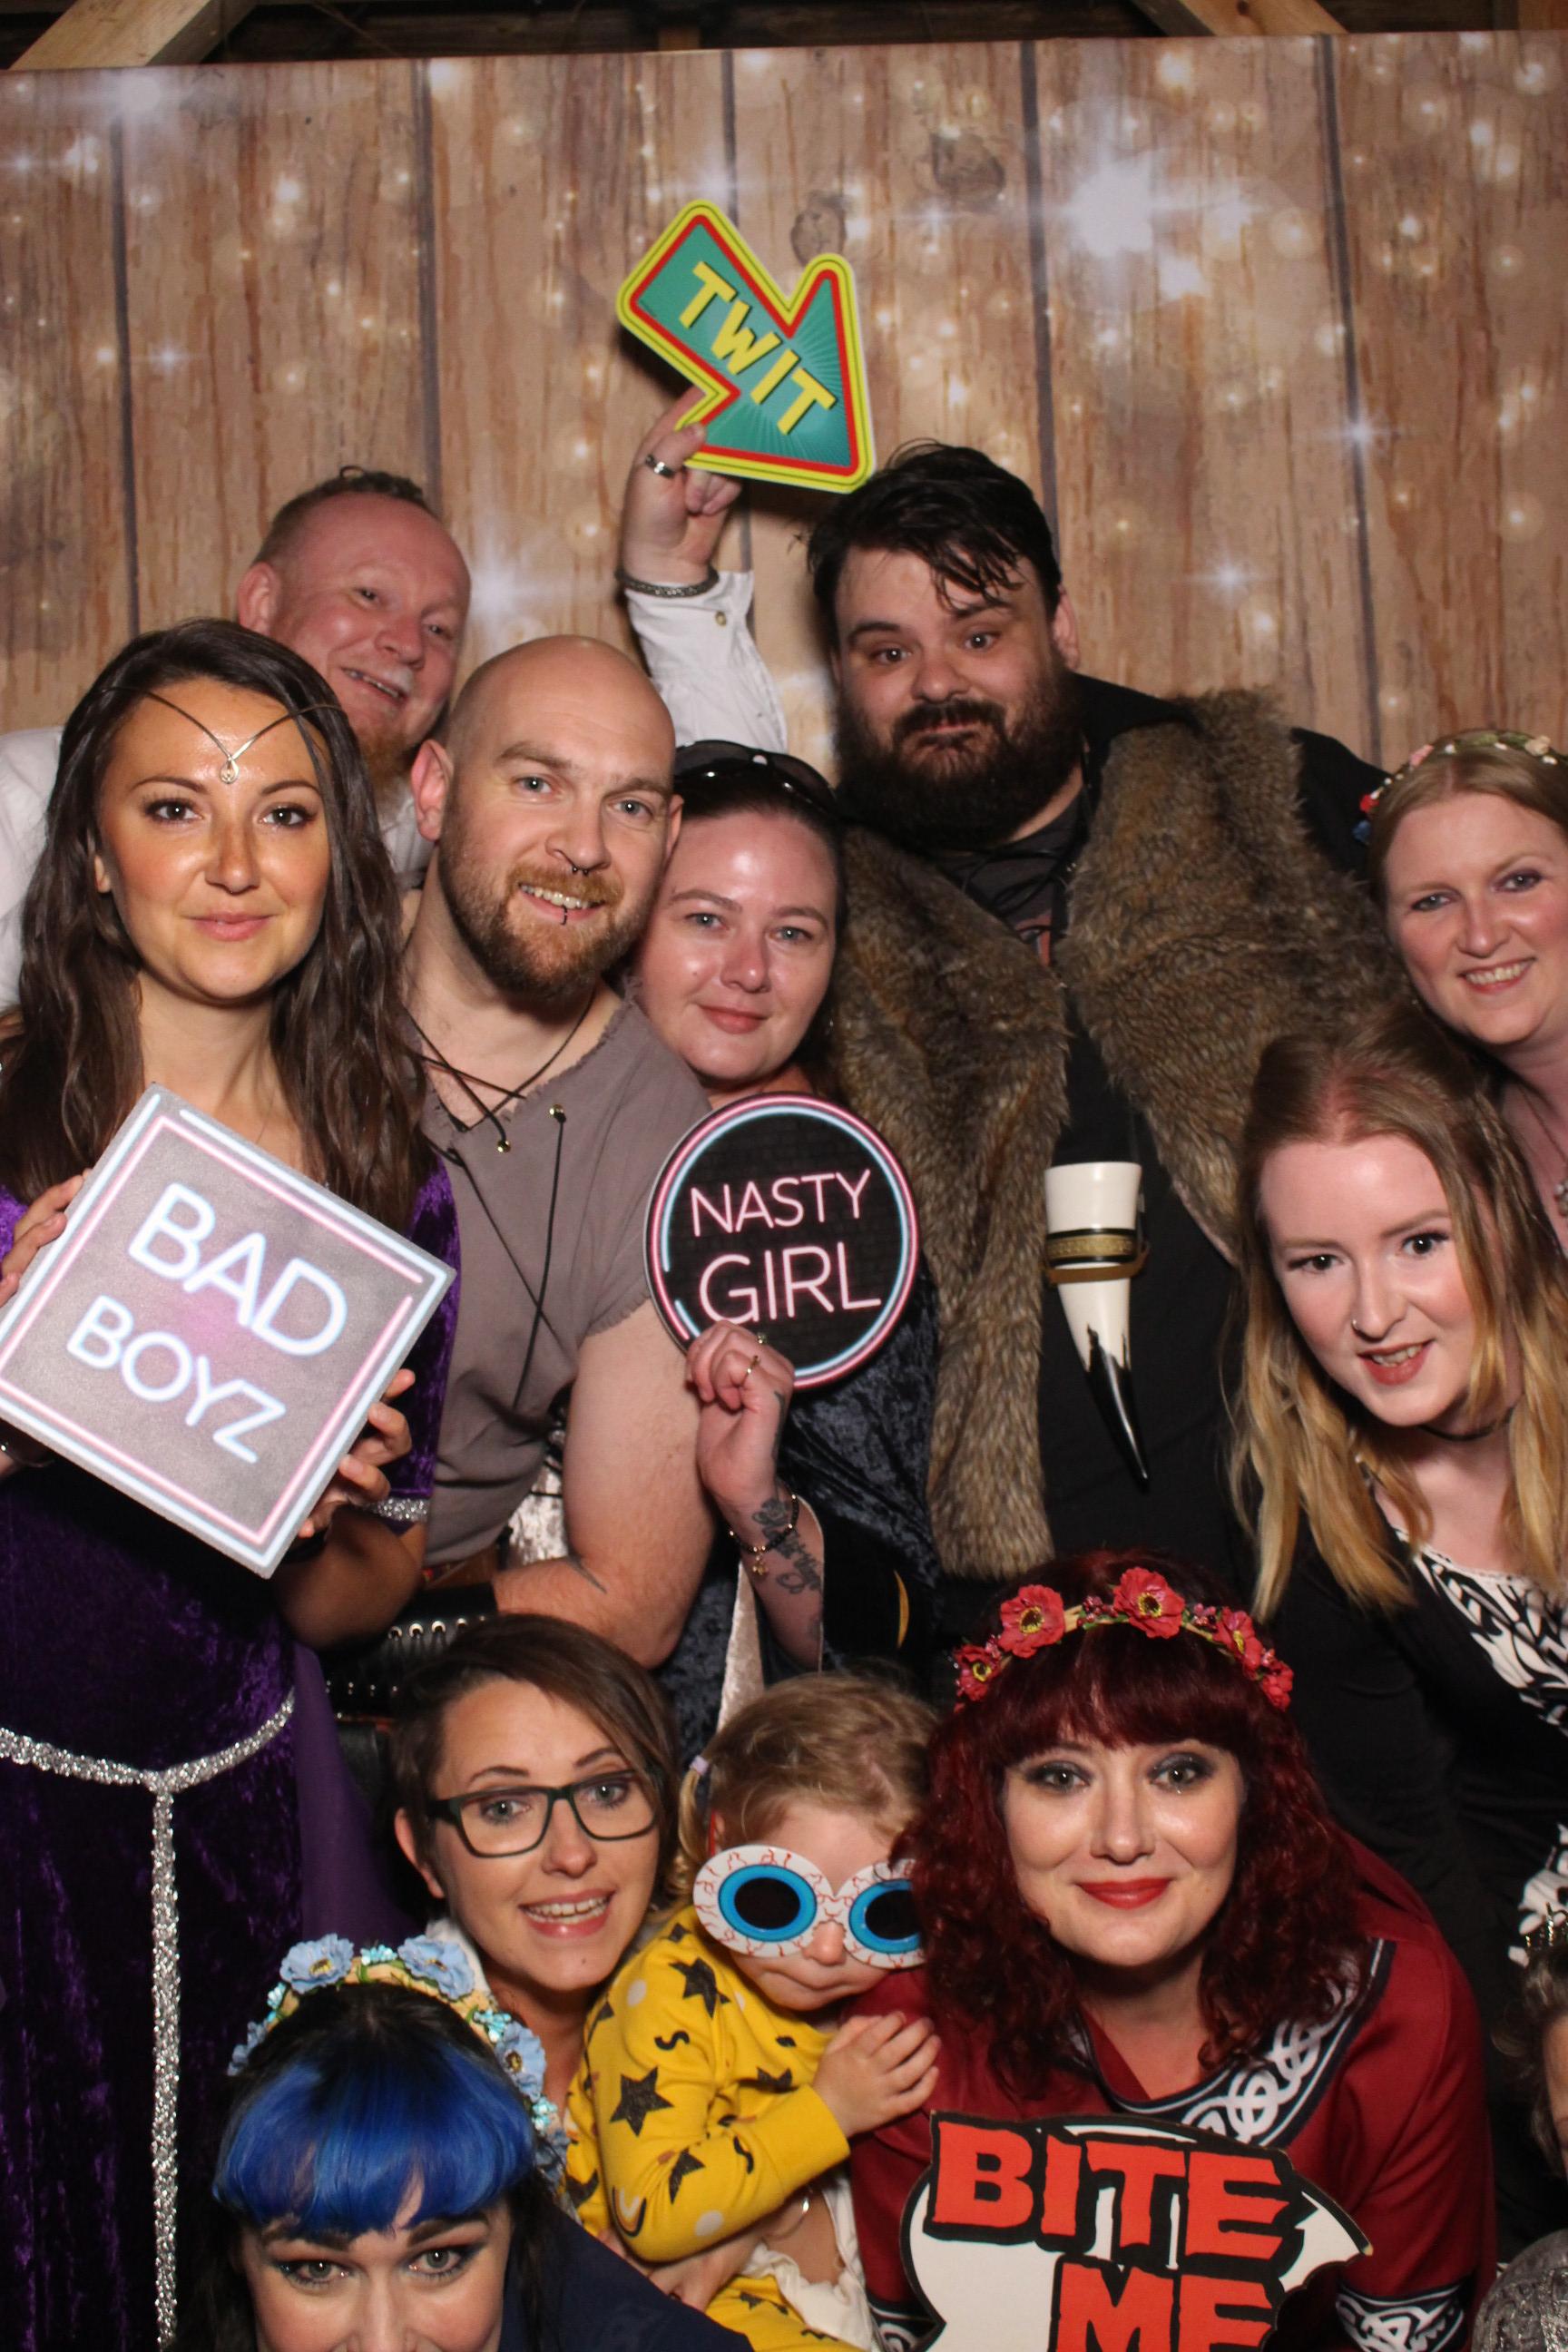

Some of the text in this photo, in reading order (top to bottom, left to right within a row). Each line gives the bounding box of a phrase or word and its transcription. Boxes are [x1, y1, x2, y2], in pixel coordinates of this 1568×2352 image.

[679, 260, 838, 436] TWIT
[127, 1181, 348, 1357] BAD
[690, 1169, 872, 1238] NASTY
[699, 1241, 883, 1325] GIRL
[65, 1294, 287, 1465] BOYZ
[932, 2121, 1290, 2259] BITE
[1055, 2262, 1272, 2352] ME
